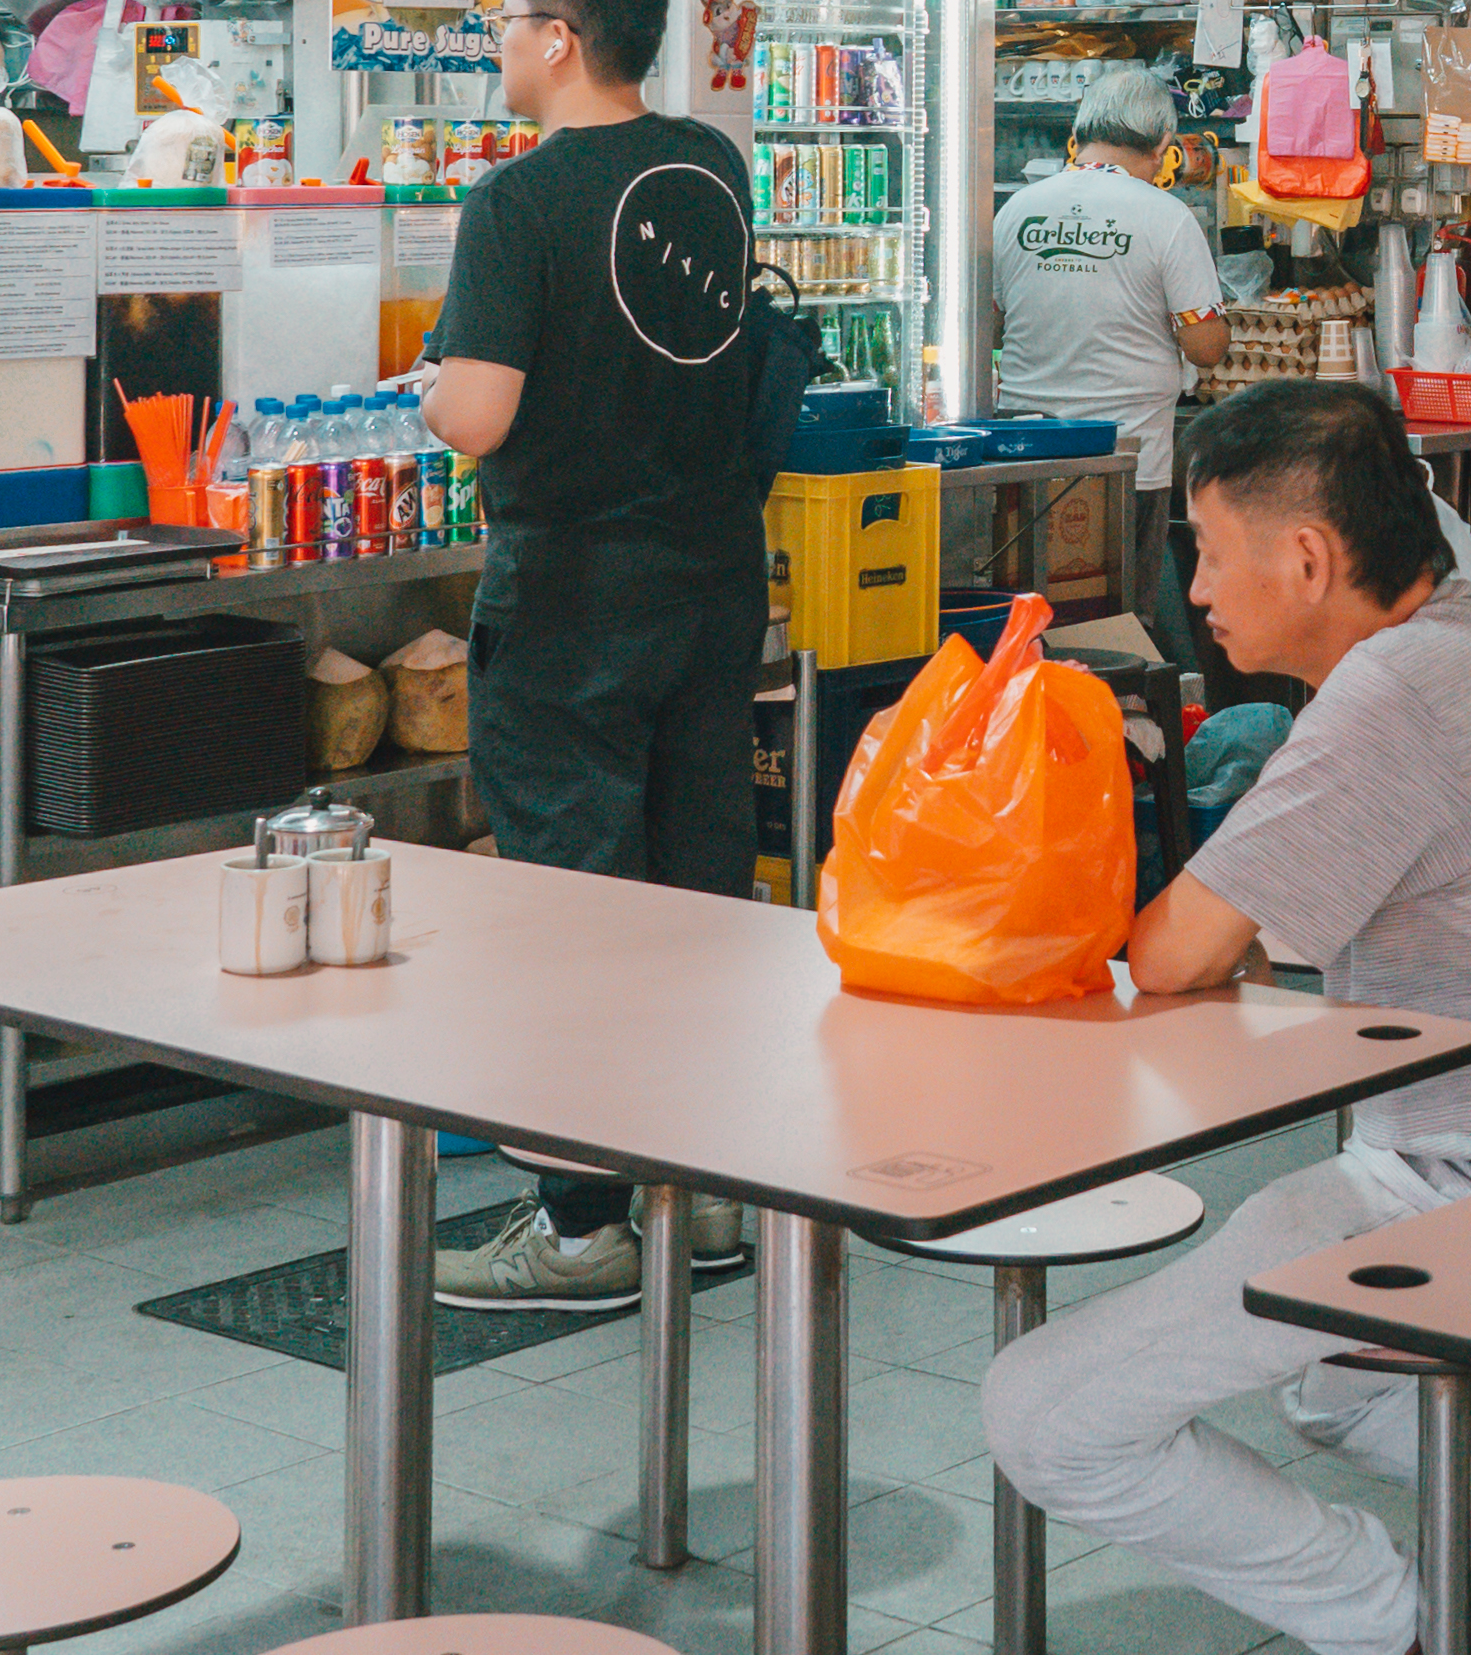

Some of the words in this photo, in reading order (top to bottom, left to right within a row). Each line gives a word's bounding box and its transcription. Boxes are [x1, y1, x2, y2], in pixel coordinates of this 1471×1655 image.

[363, 22, 429, 54] Pure
[435, 24, 503, 60] Suga
[257, 127, 283, 138] HOSEN
[398, 128, 422, 138] HOSEN
[455, 128, 480, 138] HOSEN
[1017, 216, 1133, 256] Carlsberg
[1037, 262, 1098, 273] FOOTBALL
[945, 444, 969, 462] Tiger
[861, 570, 905, 586] Heineken
